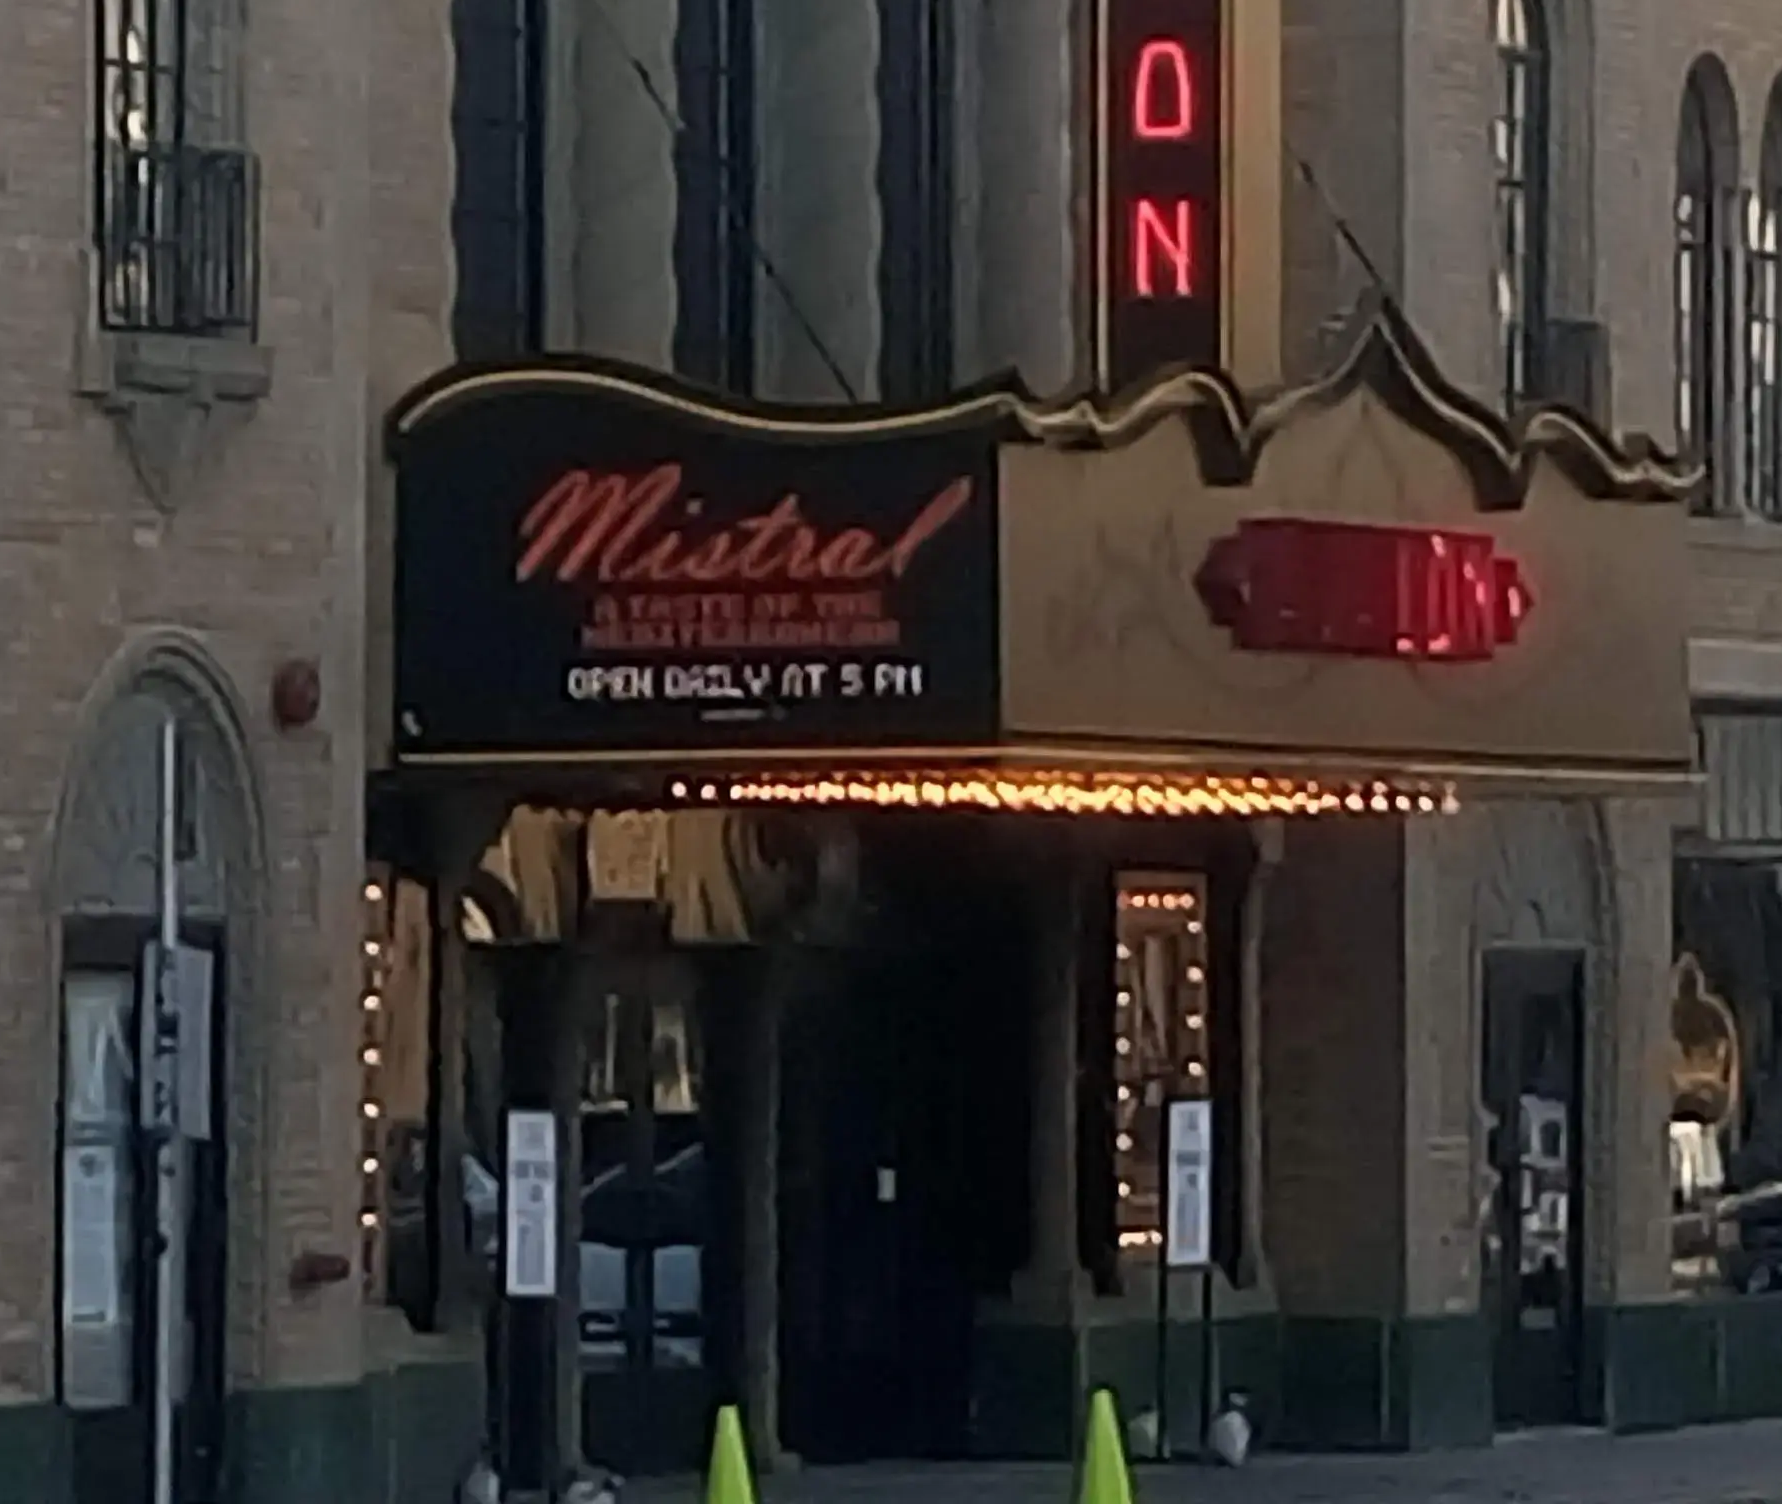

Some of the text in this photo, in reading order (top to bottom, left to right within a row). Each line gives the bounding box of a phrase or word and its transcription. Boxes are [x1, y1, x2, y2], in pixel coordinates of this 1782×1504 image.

[516, 462, 973, 582] Mistral
[567, 661, 923, 699] OPEN DAILY AT 5 PM
